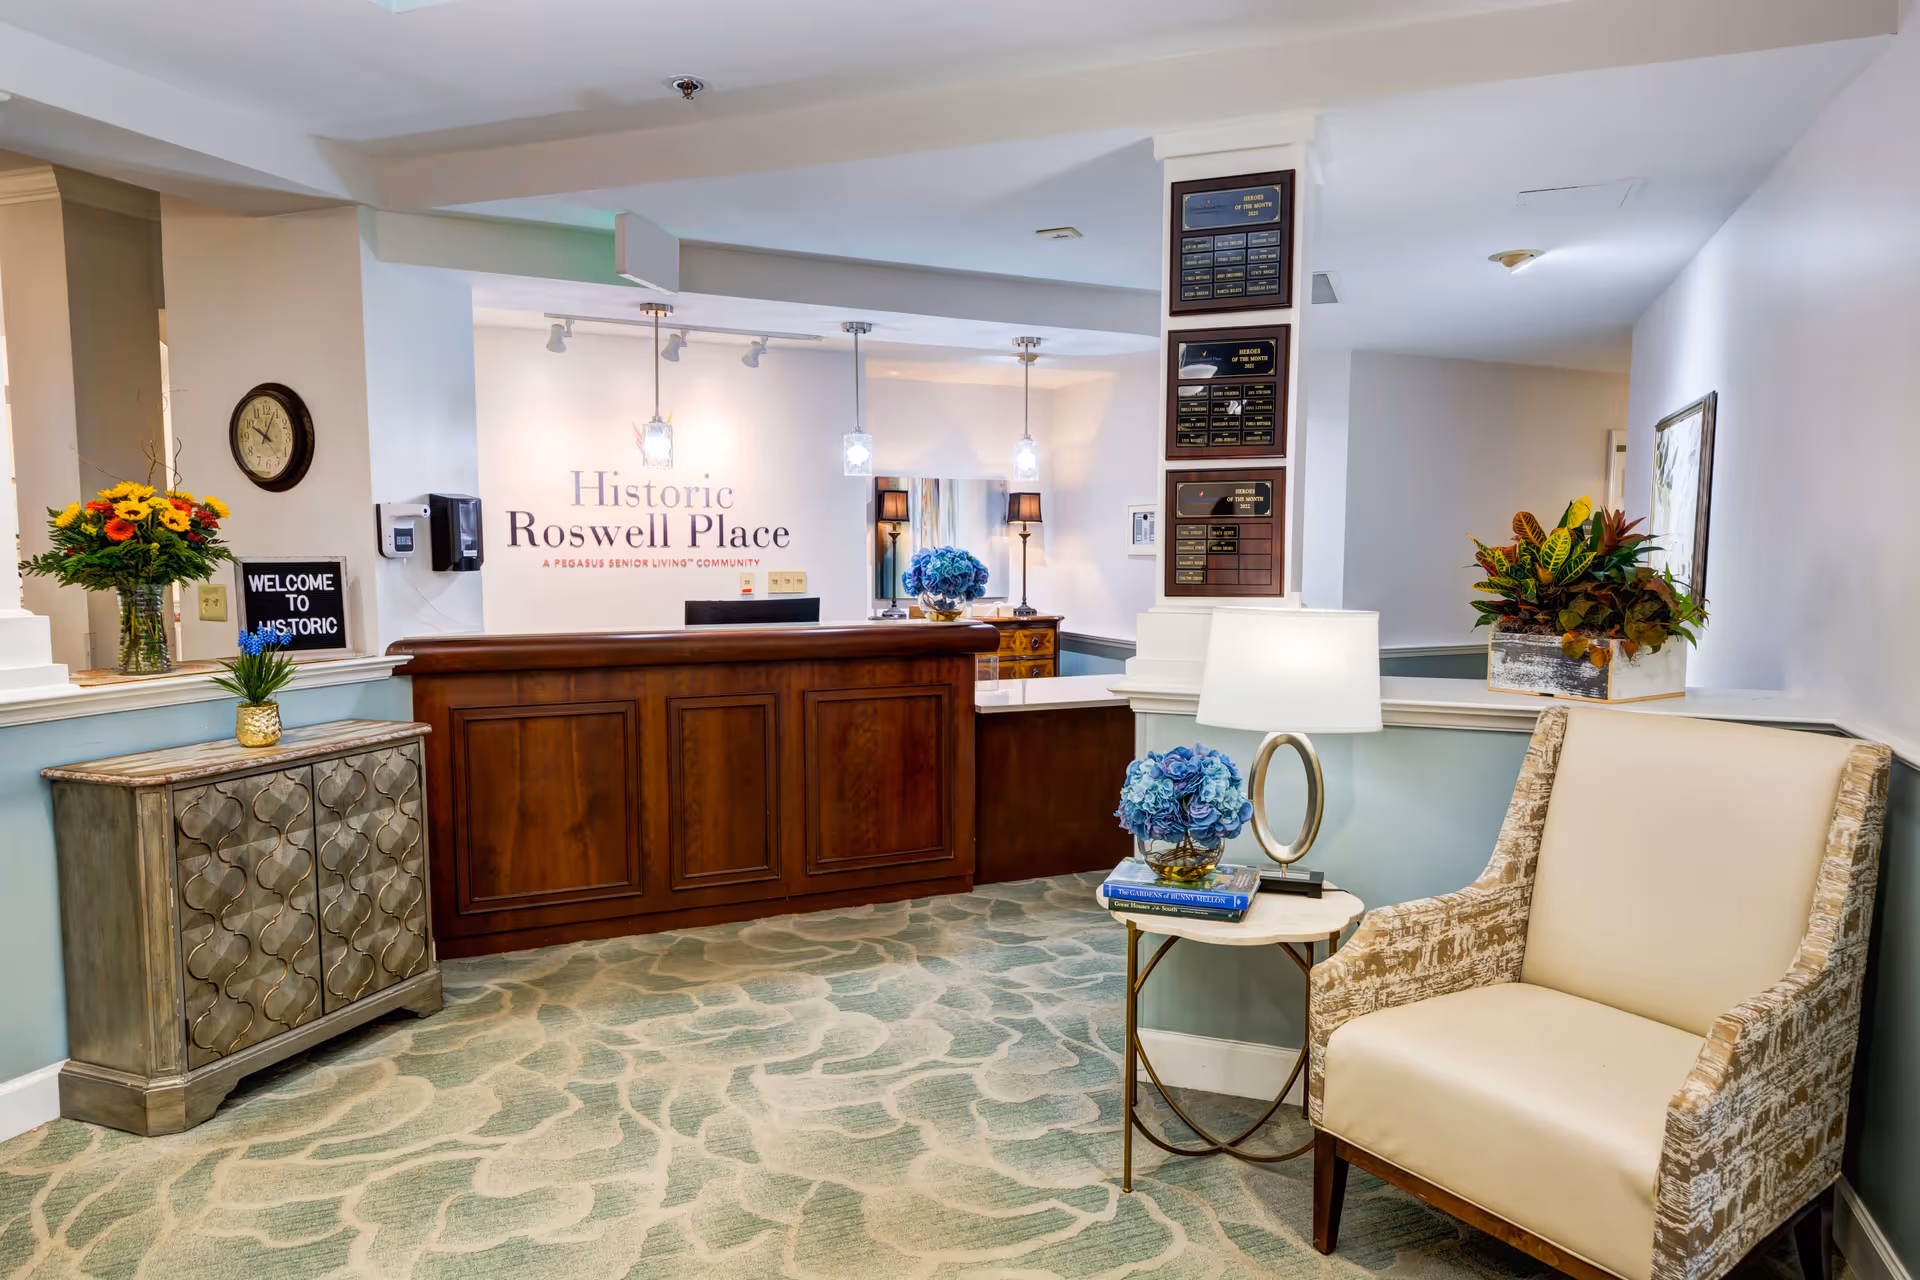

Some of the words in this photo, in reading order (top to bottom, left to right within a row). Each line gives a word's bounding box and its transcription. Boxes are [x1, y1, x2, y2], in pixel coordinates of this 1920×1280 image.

[570, 470, 734, 509] Historic
[506, 511, 670, 548] Roswell
[687, 513, 791, 548] Place
[542, 559, 550, 568] A
[554, 558, 605, 568] PEGASUS
[609, 558, 648, 568] SENIOR
[697, 558, 760, 568] COMMUNITY
[248, 574, 334, 592] WELCOME
[285, 594, 309, 612] TO
[1130, 890, 1162, 898] GARDENS
[1196, 896, 1226, 904] MELLON
